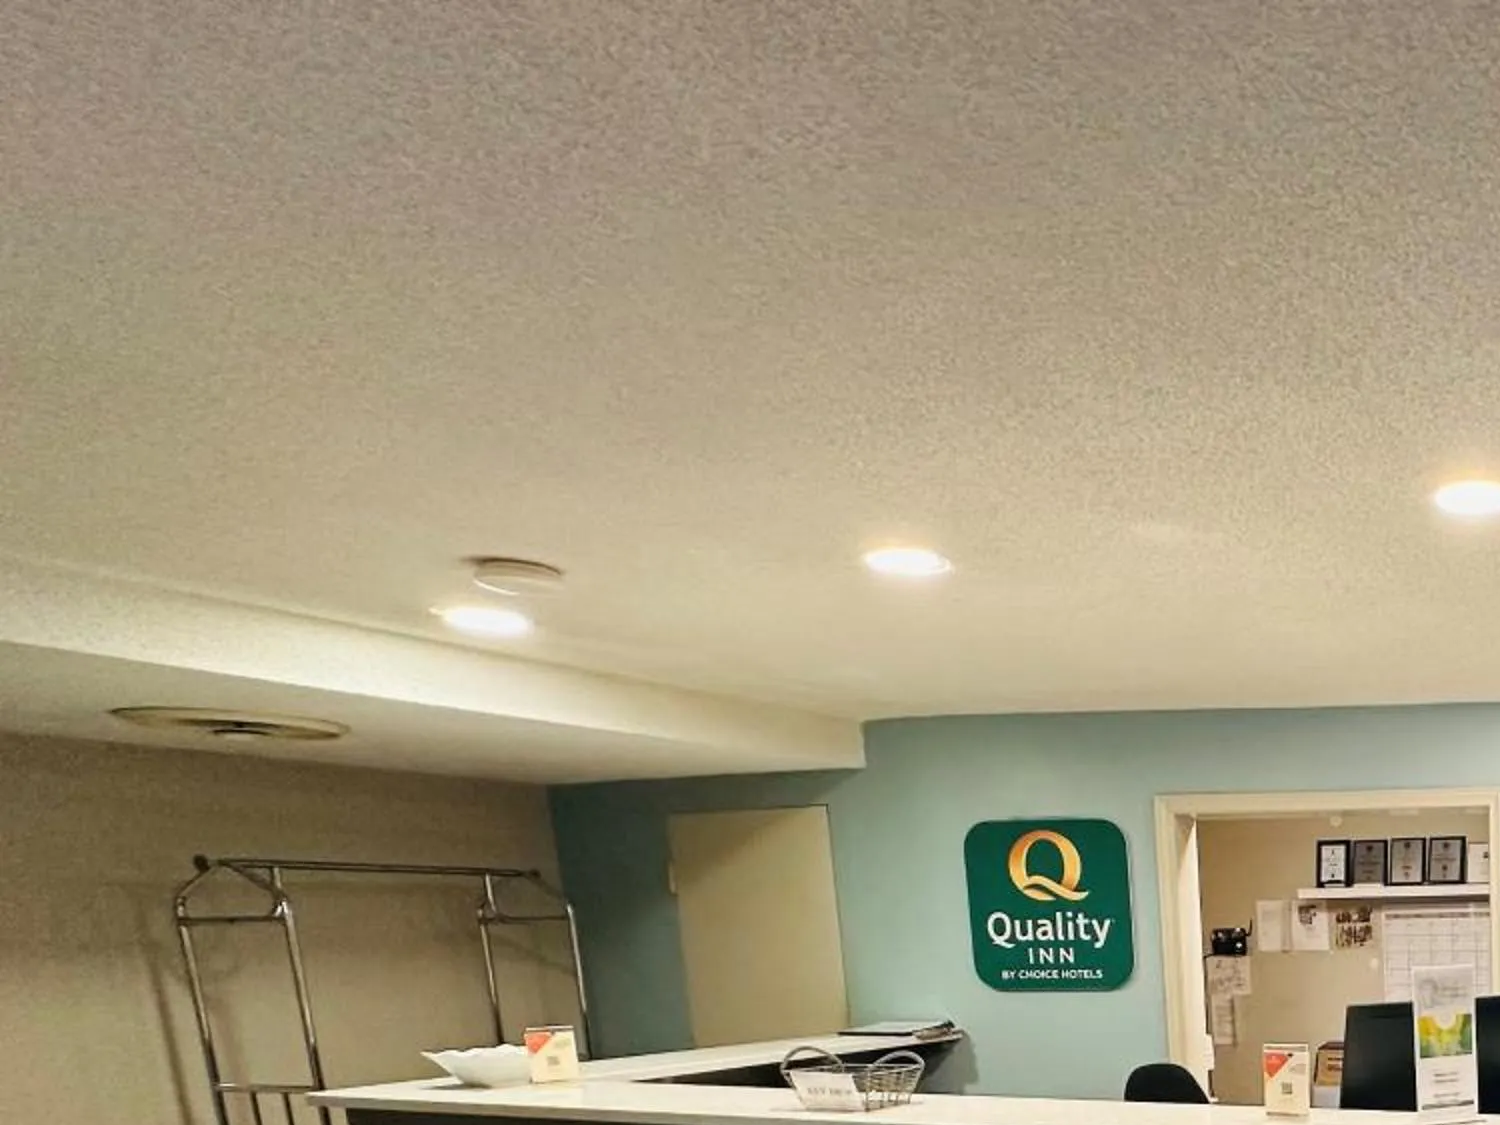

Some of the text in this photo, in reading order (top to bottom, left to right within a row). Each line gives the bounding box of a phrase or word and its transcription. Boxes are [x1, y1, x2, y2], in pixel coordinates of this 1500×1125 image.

[1008, 830, 1090, 901] Q
[986, 911, 1112, 948] Quality
[1027, 948, 1076, 965] INN
[1001, 969, 1104, 980] BY CHOICE HOTELS
